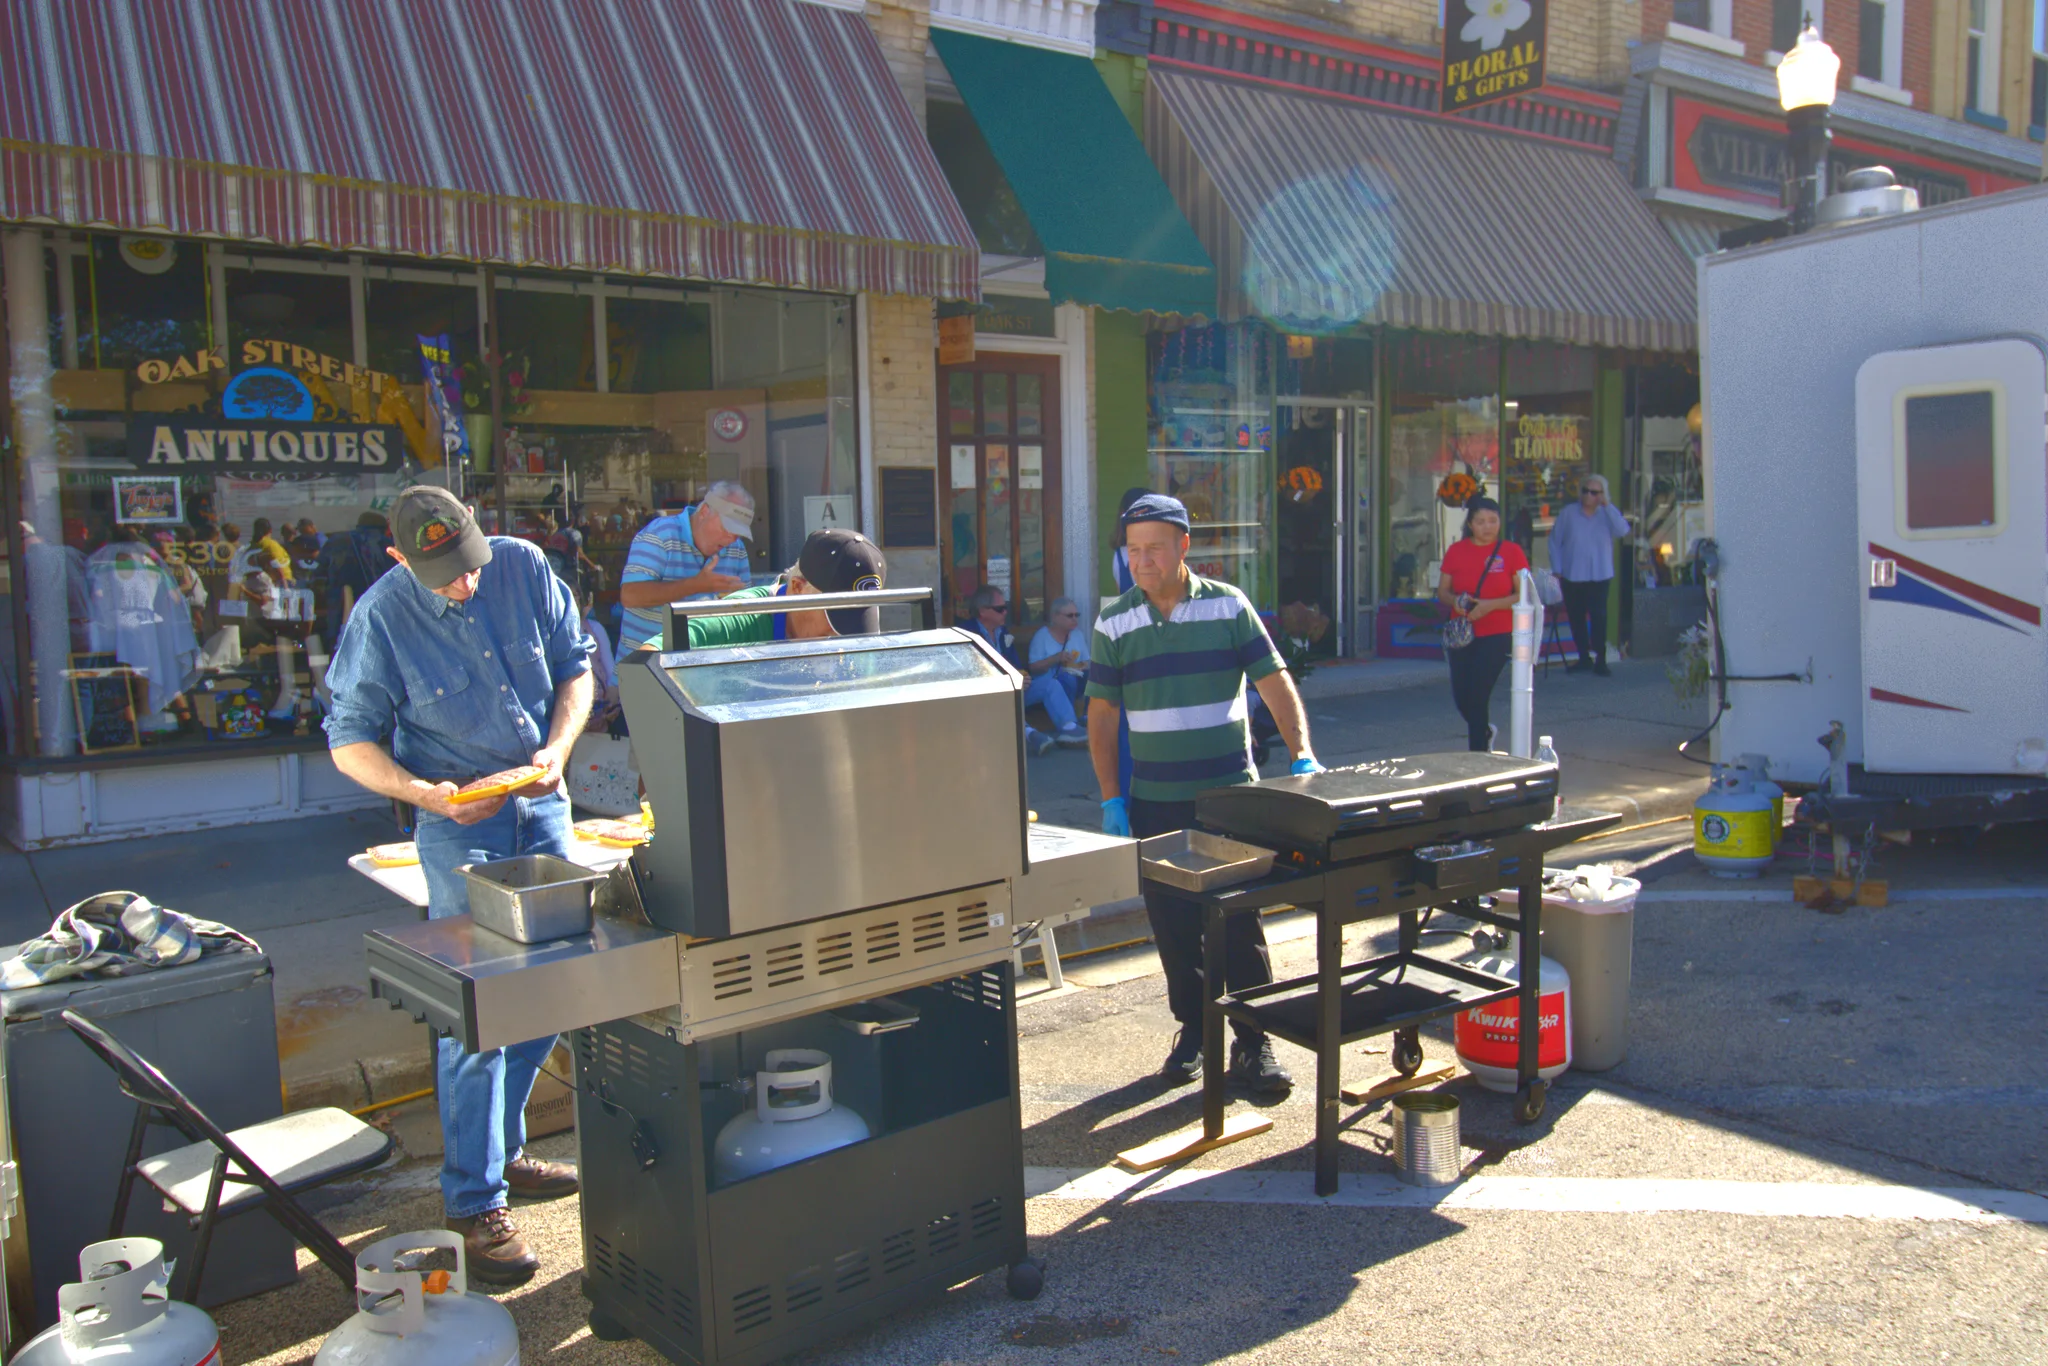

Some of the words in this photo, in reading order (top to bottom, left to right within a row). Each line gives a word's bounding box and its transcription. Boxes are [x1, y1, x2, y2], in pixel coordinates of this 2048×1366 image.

[1447, 41, 1539, 87] FLORAL
[1455, 85, 1468, 102] &
[1475, 67, 1529, 96] GIFTS
[1710, 132, 1796, 183] VILLA
[137, 344, 227, 384] OAK
[242, 339, 388, 393] STREET
[148, 426, 388, 466] ANTIQUES
[1514, 437, 1582, 460] FLOWERS
[821, 502, 837, 521] A
[164, 541, 236, 565] 530
[1467, 1007, 1520, 1029] KWIK
[1486, 1032, 1520, 1044] PROP
